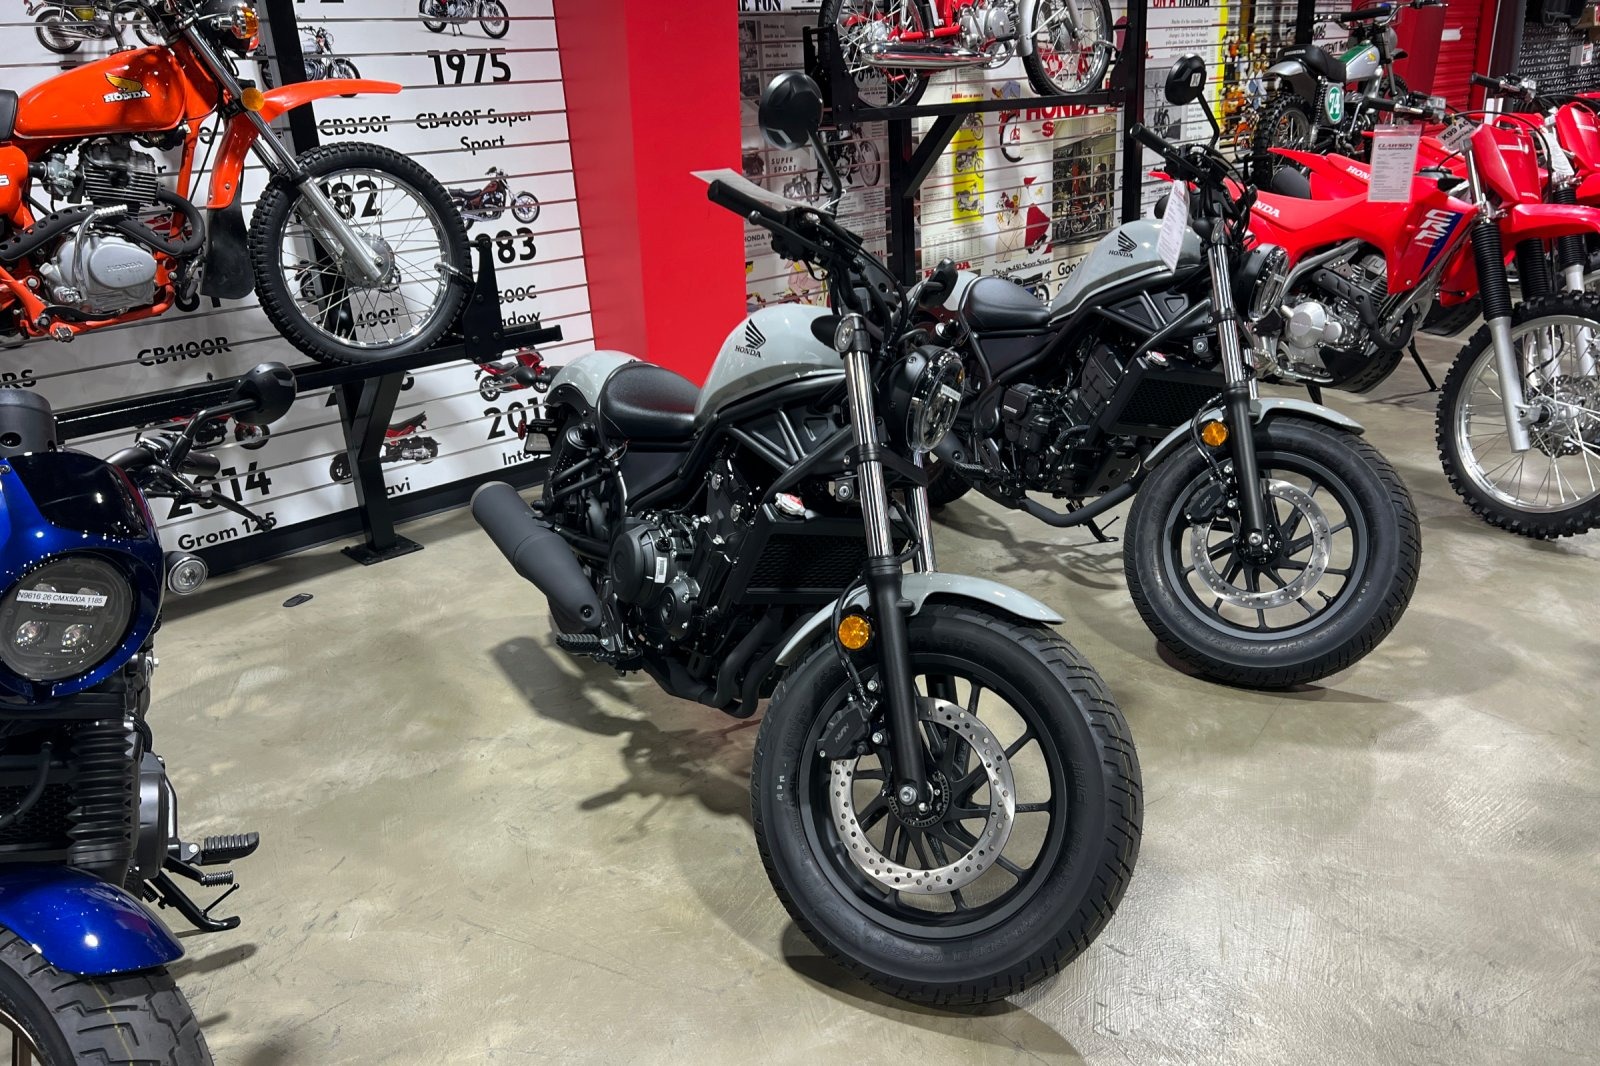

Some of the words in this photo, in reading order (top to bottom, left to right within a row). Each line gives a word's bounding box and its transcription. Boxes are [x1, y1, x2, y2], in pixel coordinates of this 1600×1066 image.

[428, 48, 512, 86] 1975
[104, 91, 151, 104] HONDA
[1329, 93, 1341, 114] 74
[415, 110, 482, 131] CB400F
[487, 108, 533, 129] Super
[1026, 104, 1099, 121] HONDA
[319, 115, 391, 137] CB350F
[460, 135, 505, 156] Sport
[771, 157, 794, 165] SUPER
[774, 164, 797, 173] SPORT
[1346, 165, 1371, 180] HON
[1252, 200, 1280, 217] NDA
[495, 227, 536, 264] 83
[1108, 249, 1134, 259] HONDA
[1057, 262, 1079, 276] Goo
[355, 308, 399, 329] 400F
[137, 336, 233, 367] CB1100R
[735, 344, 762, 359] HONDA
[0, 369, 37, 389] RS
[483, 397, 541, 440] 201
[387, 477, 412, 497] avi
[178, 527, 238, 550] Grom
[42, 593, 52, 601] 26
[52, 594, 86, 603] CMX500A
